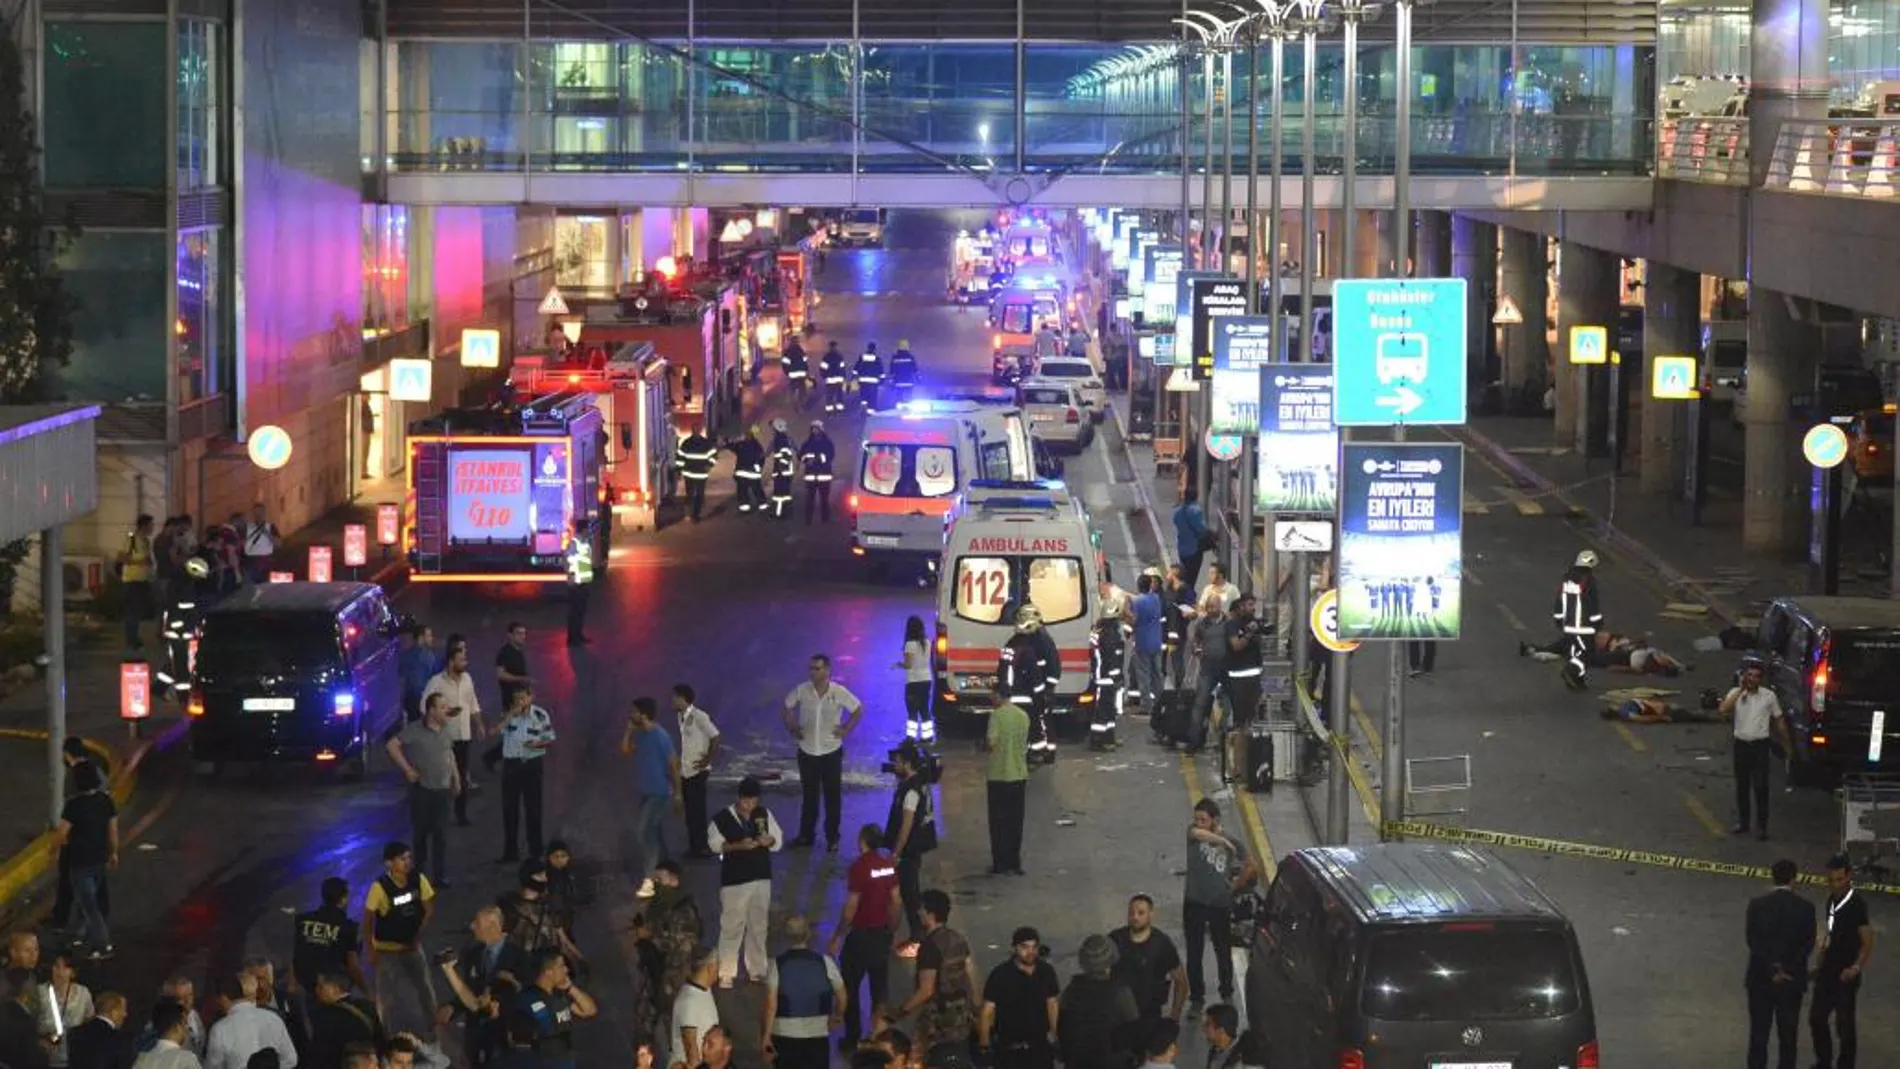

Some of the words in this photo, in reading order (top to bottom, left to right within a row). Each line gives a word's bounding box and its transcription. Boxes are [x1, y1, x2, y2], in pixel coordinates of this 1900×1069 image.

[1367, 498, 1387, 517] EN
[969, 538, 1068, 552] AMBULANS
[961, 570, 1005, 605] 112
[302, 920, 340, 940] TEM
